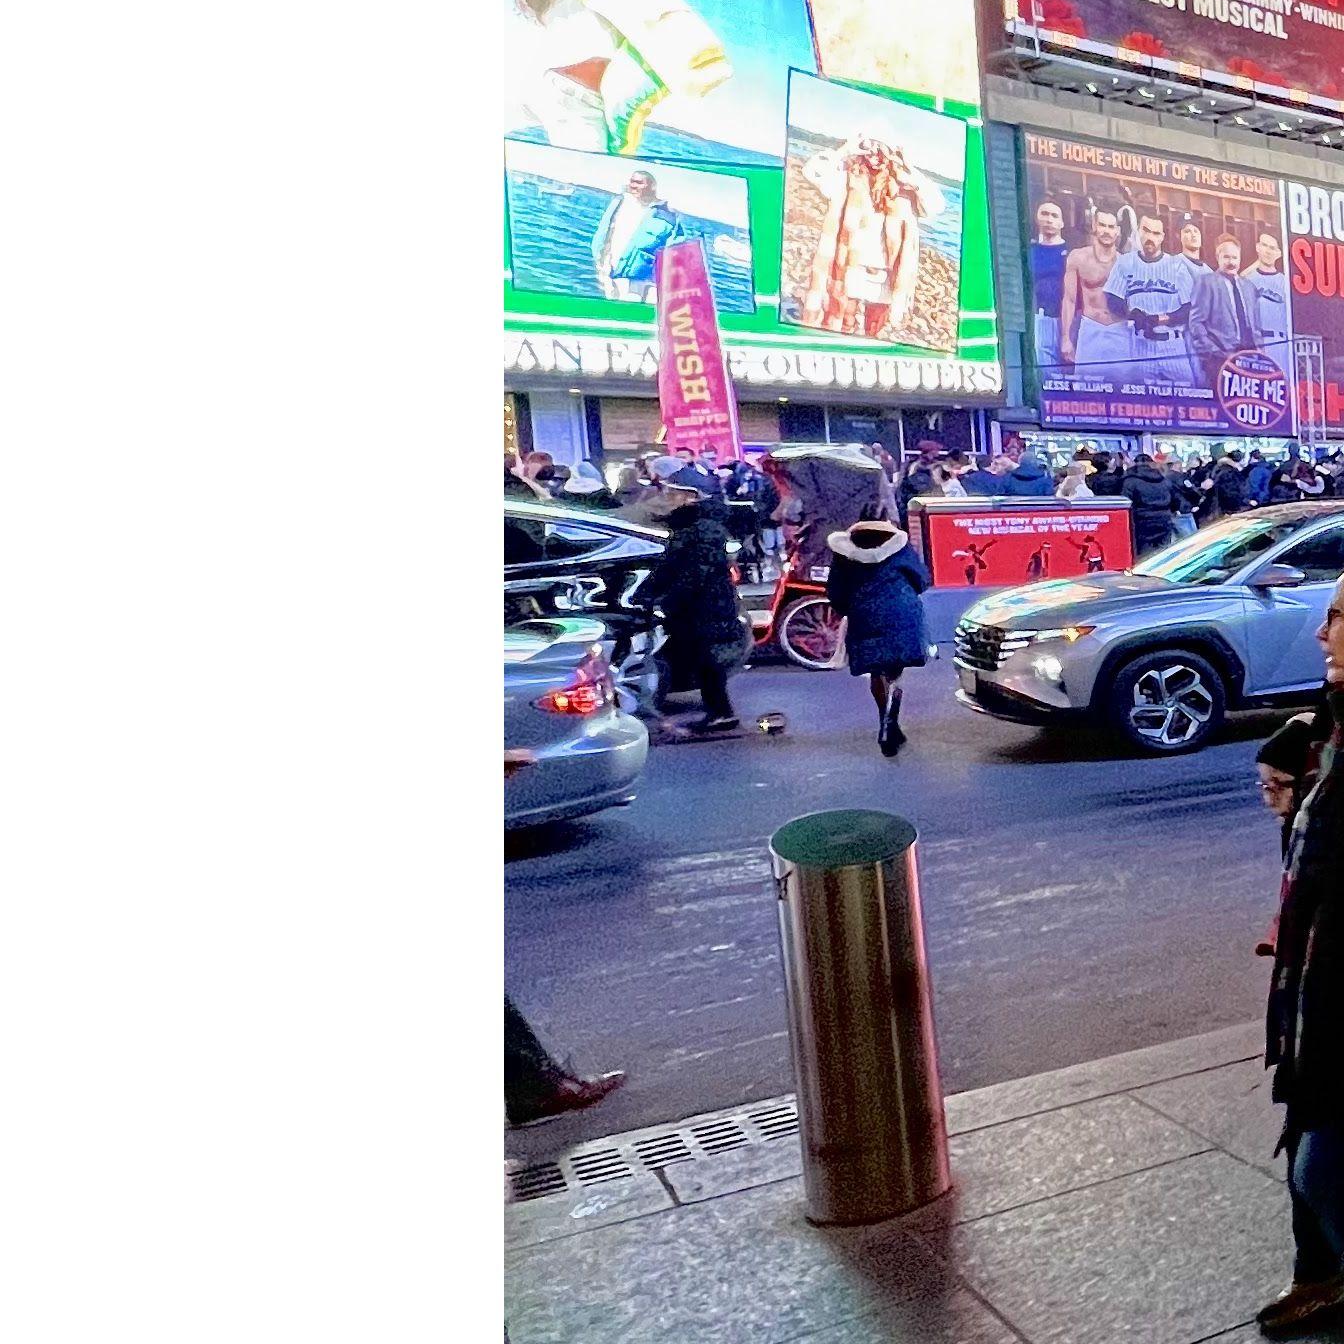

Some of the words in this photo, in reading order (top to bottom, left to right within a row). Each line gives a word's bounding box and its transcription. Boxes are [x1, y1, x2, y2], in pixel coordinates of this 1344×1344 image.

[1028, 137, 1058, 157] THE
[1062, 143, 1142, 173] HOME-RUN
[1146, 158, 1167, 177] HIT
[1172, 162, 1189, 180] OF
[1193, 167, 1219, 186] THE
[669, 304, 712, 404] WISH
[762, 353, 1002, 394] OUTFITTERS
[1043, 380, 1071, 391] JESSE
[1073, 382, 1114, 394] WILLIAMS
[1222, 369, 1261, 399] TAKE
[1263, 378, 1286, 406] ME
[1121, 384, 1147, 396] JESSE
[1045, 400, 1106, 416] THROUGH
[1111, 402, 1174, 418] FEBRUARY
[1236, 403, 1270, 425] OUT
